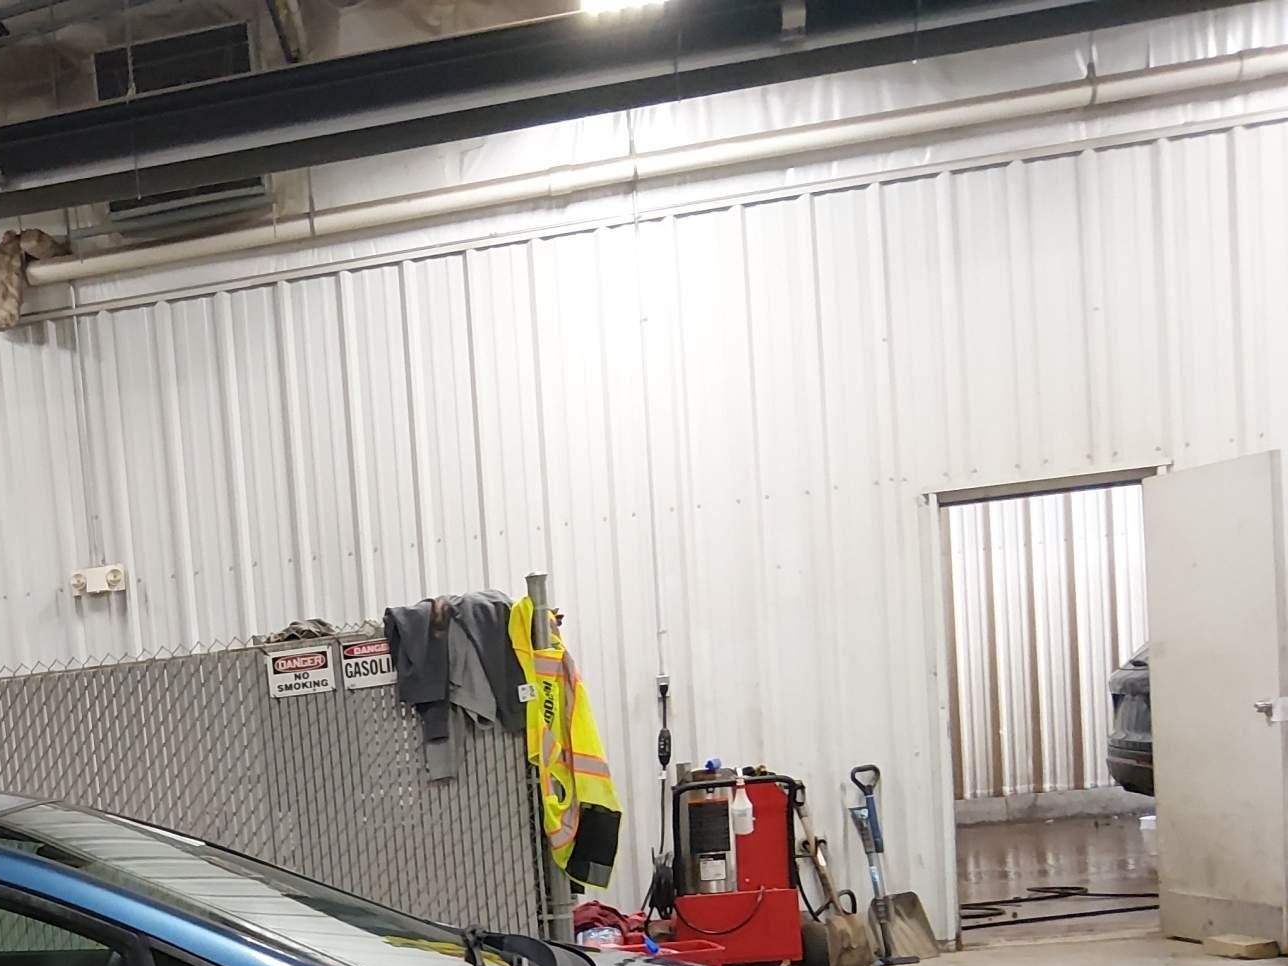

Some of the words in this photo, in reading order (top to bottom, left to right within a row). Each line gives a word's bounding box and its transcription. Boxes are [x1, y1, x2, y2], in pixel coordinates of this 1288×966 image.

[353, 643, 389, 655] DANGE
[279, 656, 321, 670] DANGER
[294, 672, 309, 680] NO
[277, 679, 328, 692] SMOKING
